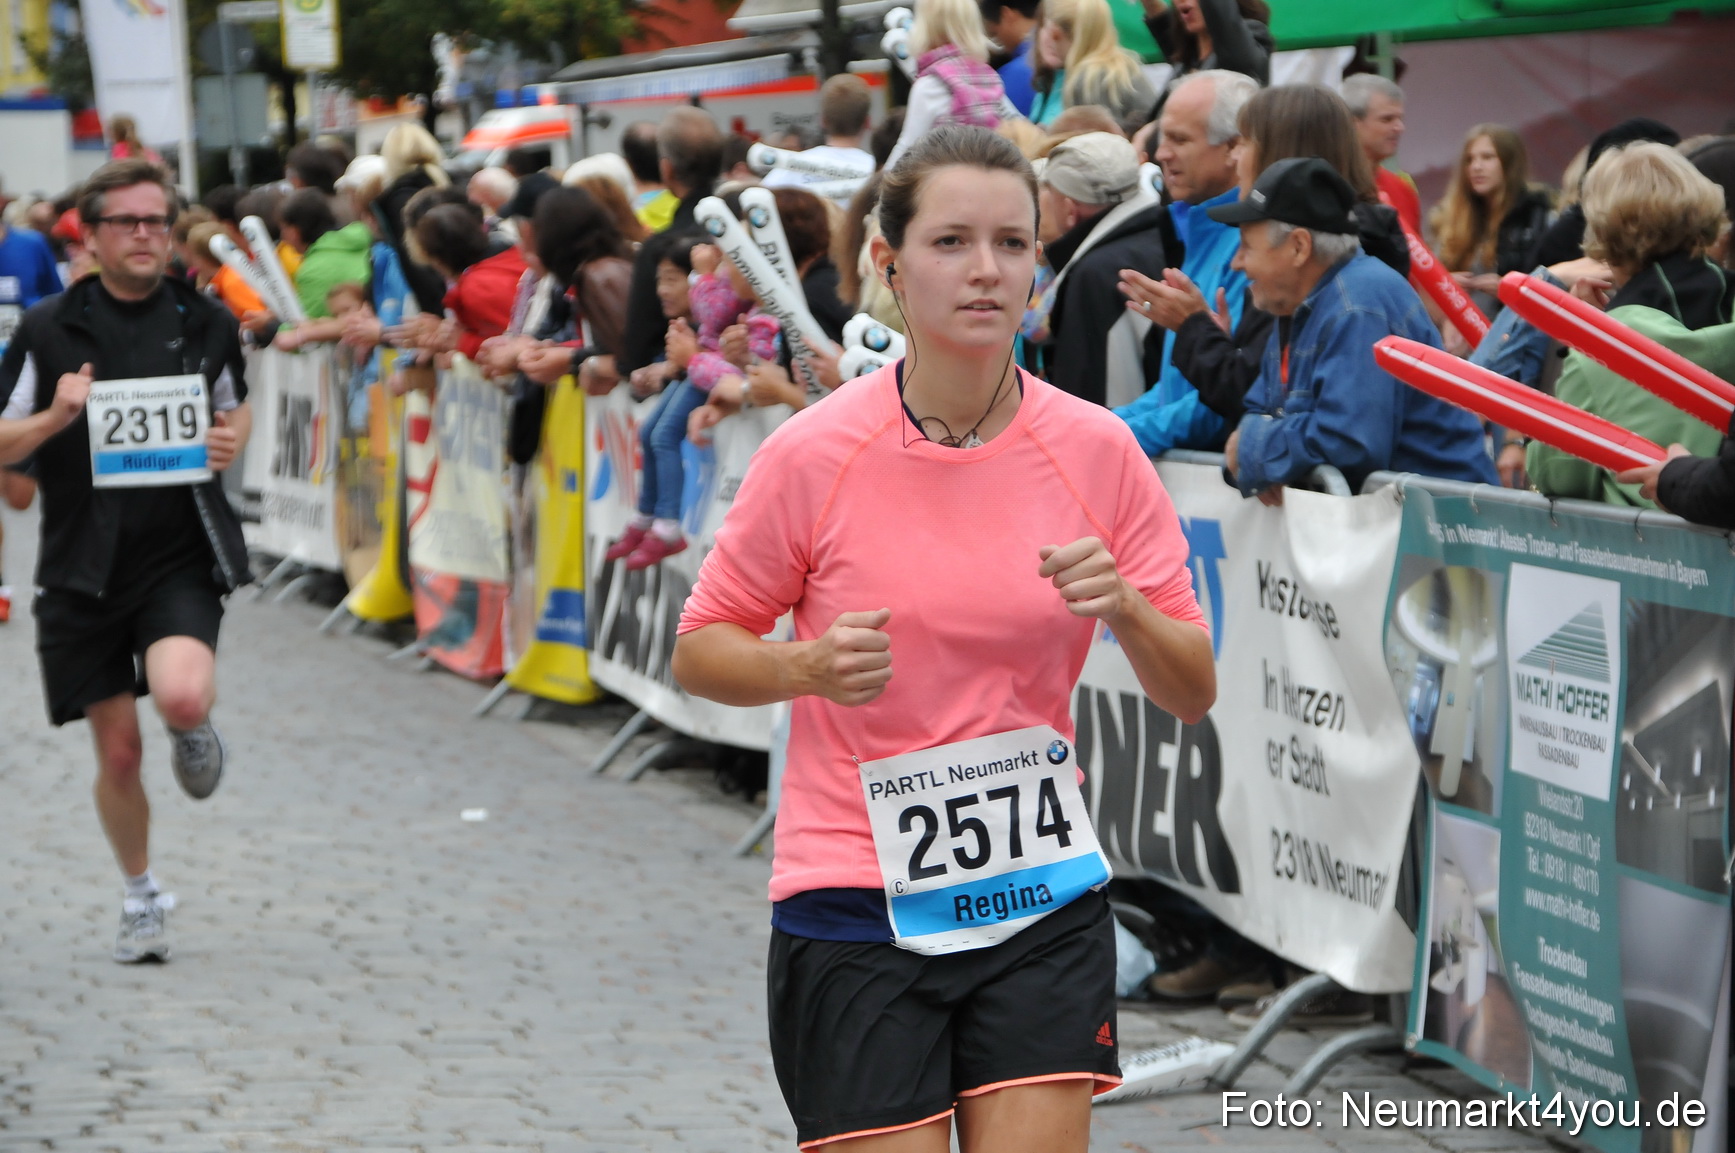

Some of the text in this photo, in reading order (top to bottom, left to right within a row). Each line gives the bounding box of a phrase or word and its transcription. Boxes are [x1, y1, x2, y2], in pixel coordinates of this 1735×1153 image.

[90, 387, 186, 403] PARTL Neumarkt
[102, 402, 198, 445] 2319
[122, 453, 182, 471] Rüdiger
[1676, 559, 1709, 590] Bayern
[1516, 671, 1610, 723] MATHI HOFFER
[1538, 741, 1580, 770] FASSADENBAU
[1562, 726, 1607, 754] TROCKENBAU
[869, 750, 1040, 800] PARTL Neumarkt
[1290, 734, 1331, 797] Stadt
[898, 776, 1073, 882] 2574
[1525, 811, 1549, 843] 92318
[1545, 852, 1567, 884] 09181
[895, 881, 904, 894] C
[953, 882, 1054, 922] Regina
[1538, 935, 1587, 979] Trockenbau
[1513, 961, 1615, 1028] Fassadenverkleidungen
